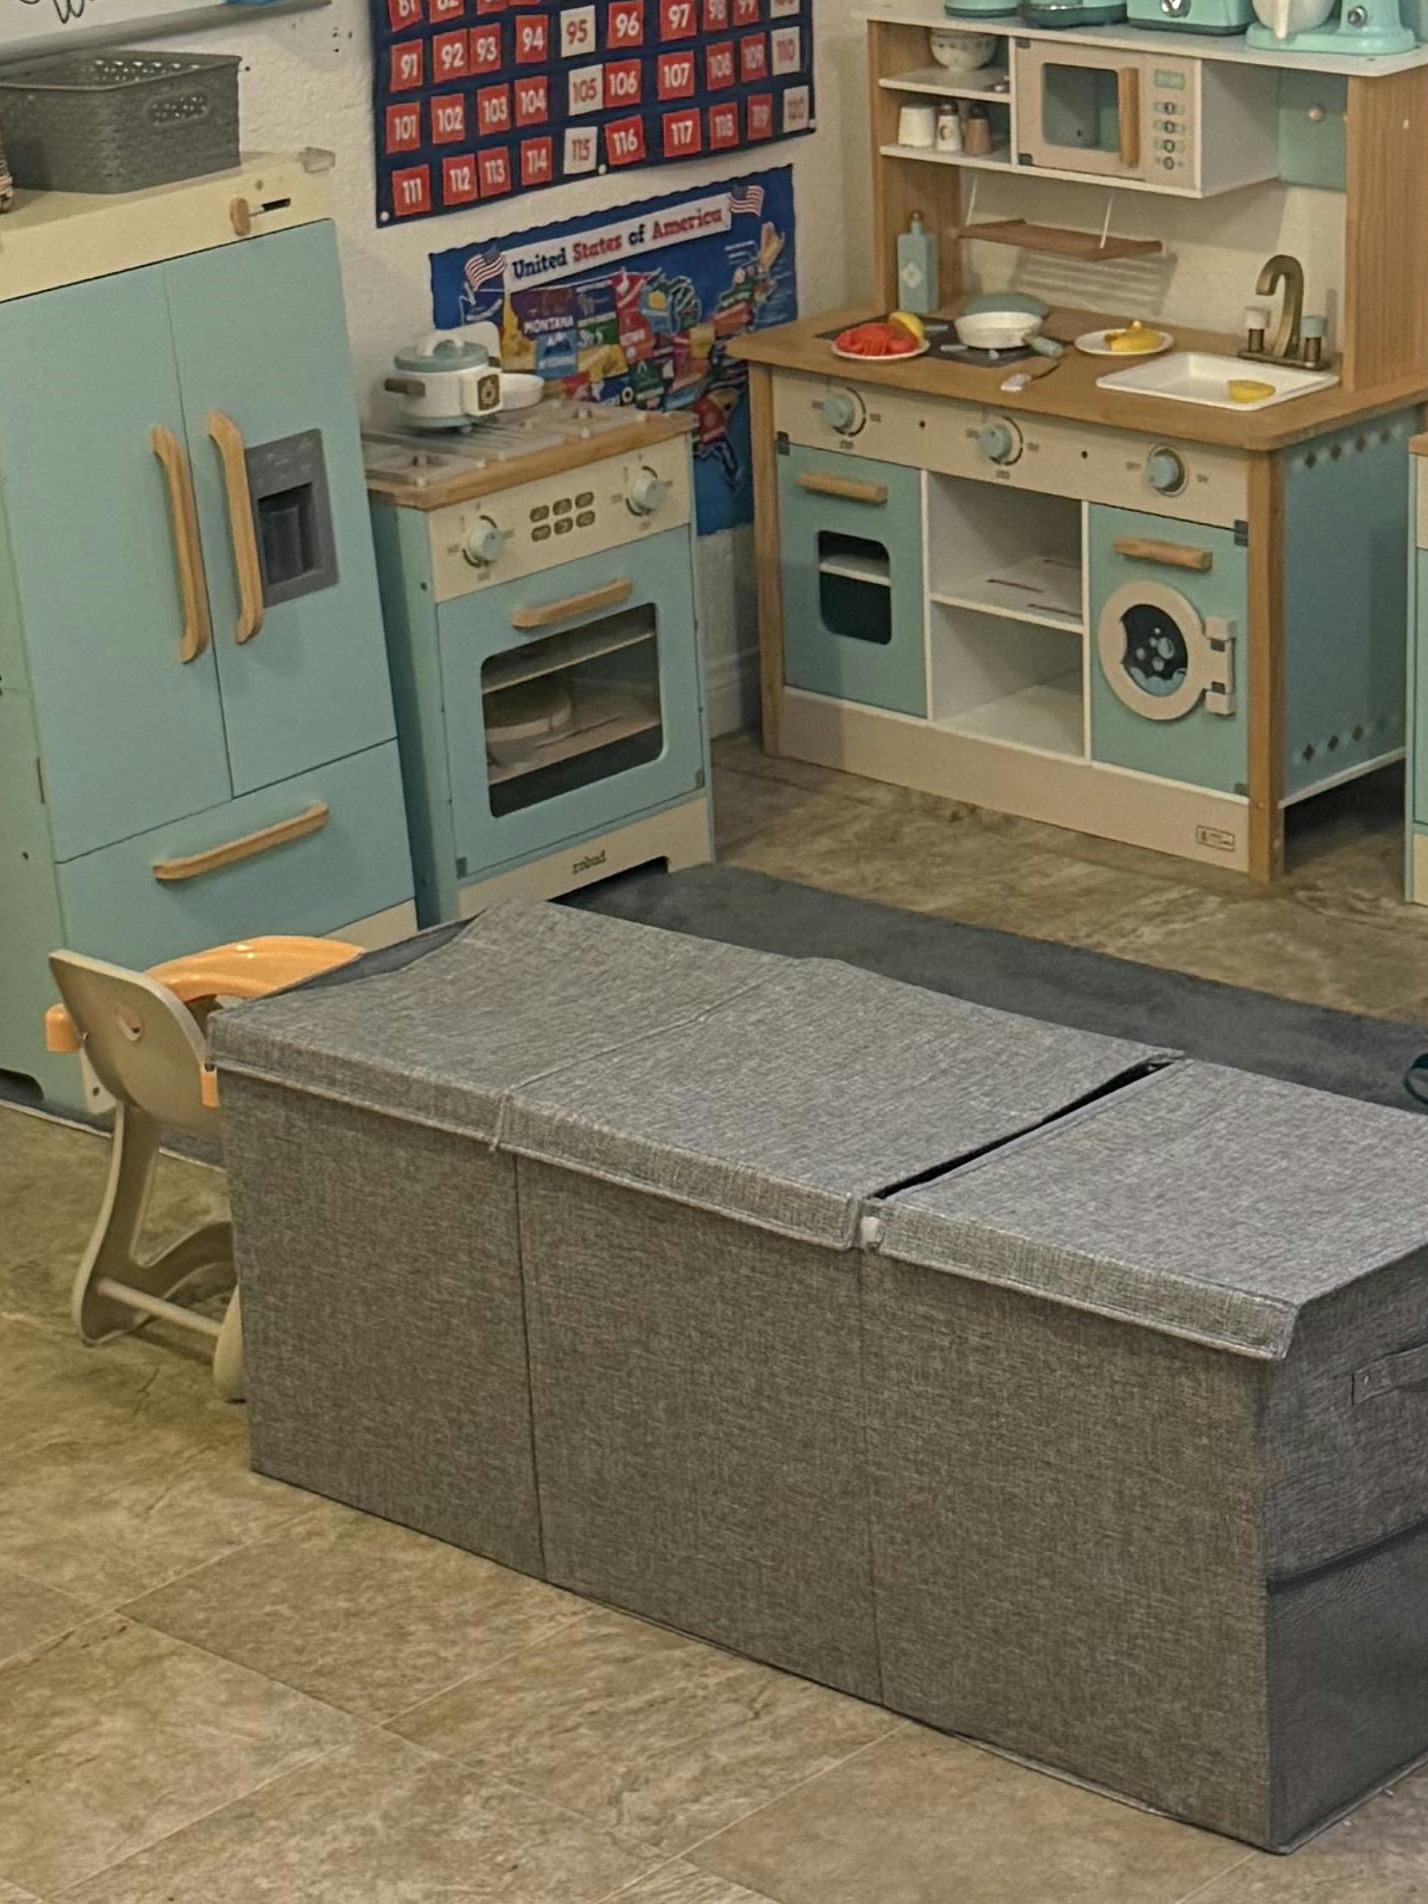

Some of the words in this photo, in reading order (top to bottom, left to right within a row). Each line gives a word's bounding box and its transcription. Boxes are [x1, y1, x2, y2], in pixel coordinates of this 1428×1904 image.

[512, 248, 568, 279] United
[572, 235, 622, 262] States
[629, 224, 645, 245] of
[652, 206, 722, 240] America
[524, 315, 573, 335] MONTANA
